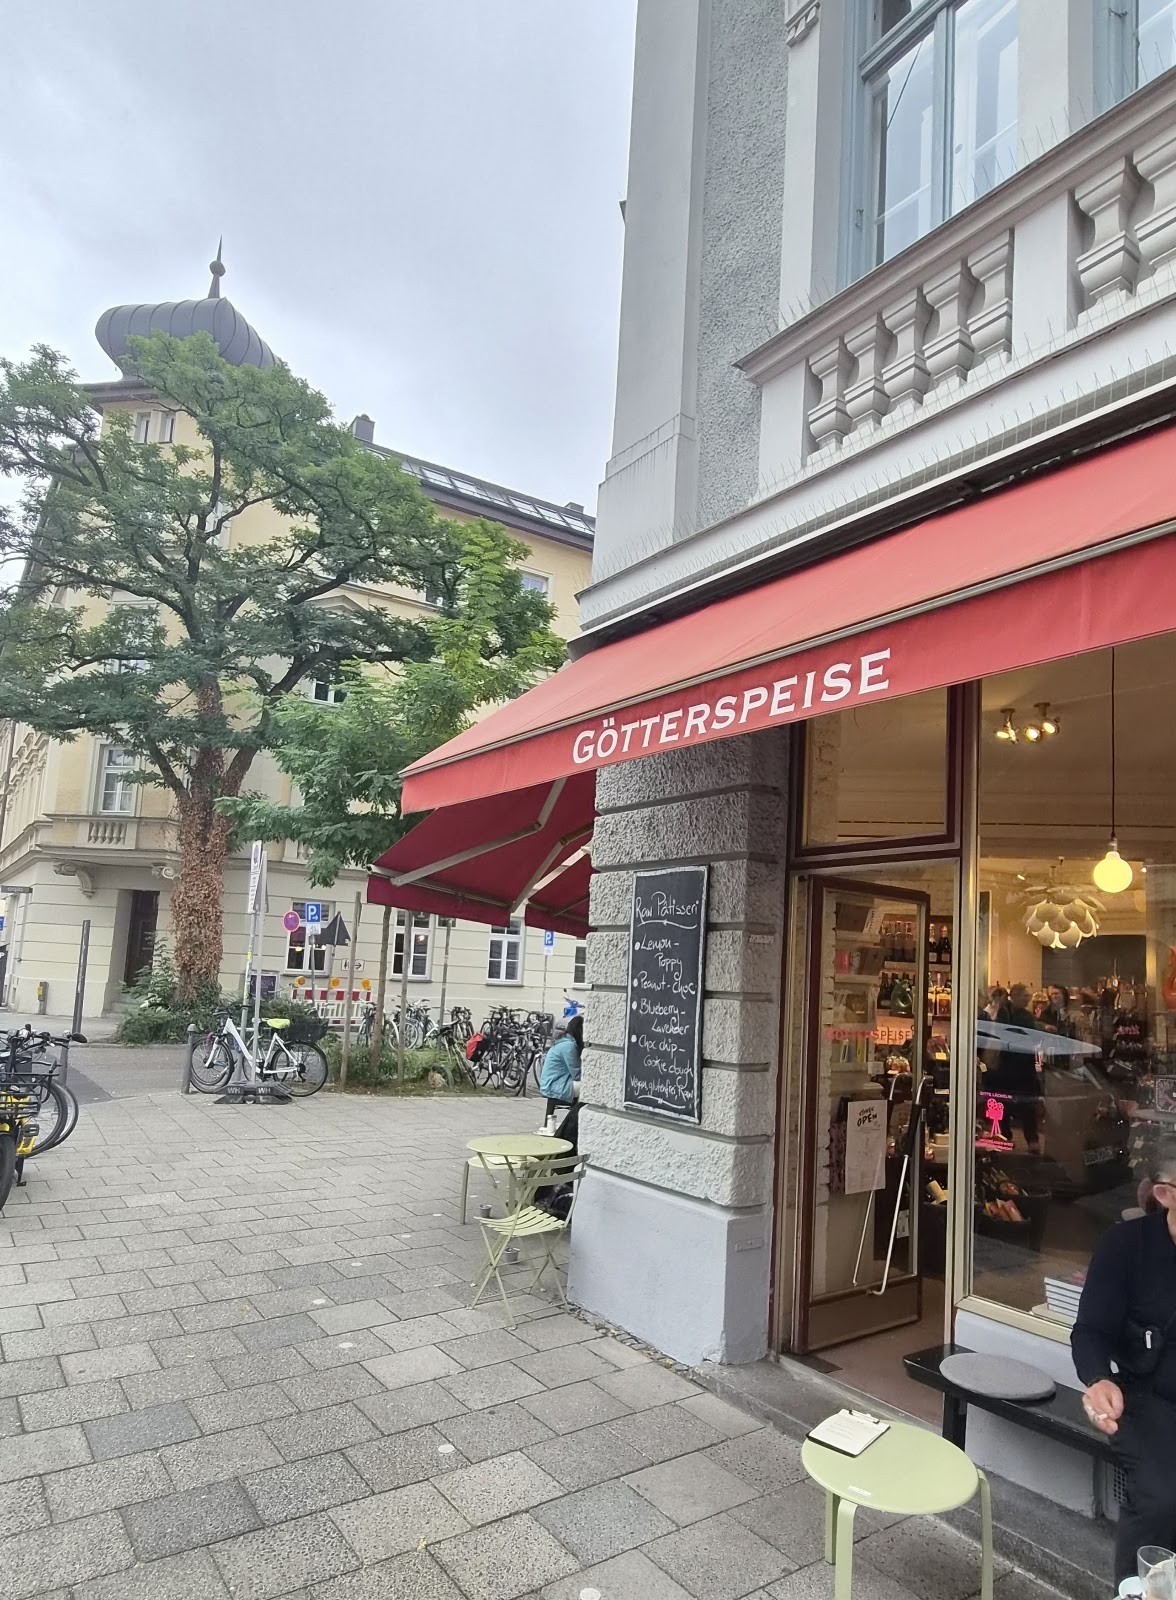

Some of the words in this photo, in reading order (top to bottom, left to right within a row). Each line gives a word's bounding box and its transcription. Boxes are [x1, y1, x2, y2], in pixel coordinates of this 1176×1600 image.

[573, 648, 890, 764] GÖTTERSPEISE
[308, 905, 317, 921] P
[636, 897, 653, 921] Raw
[654, 952, 682, 980] Poppy
